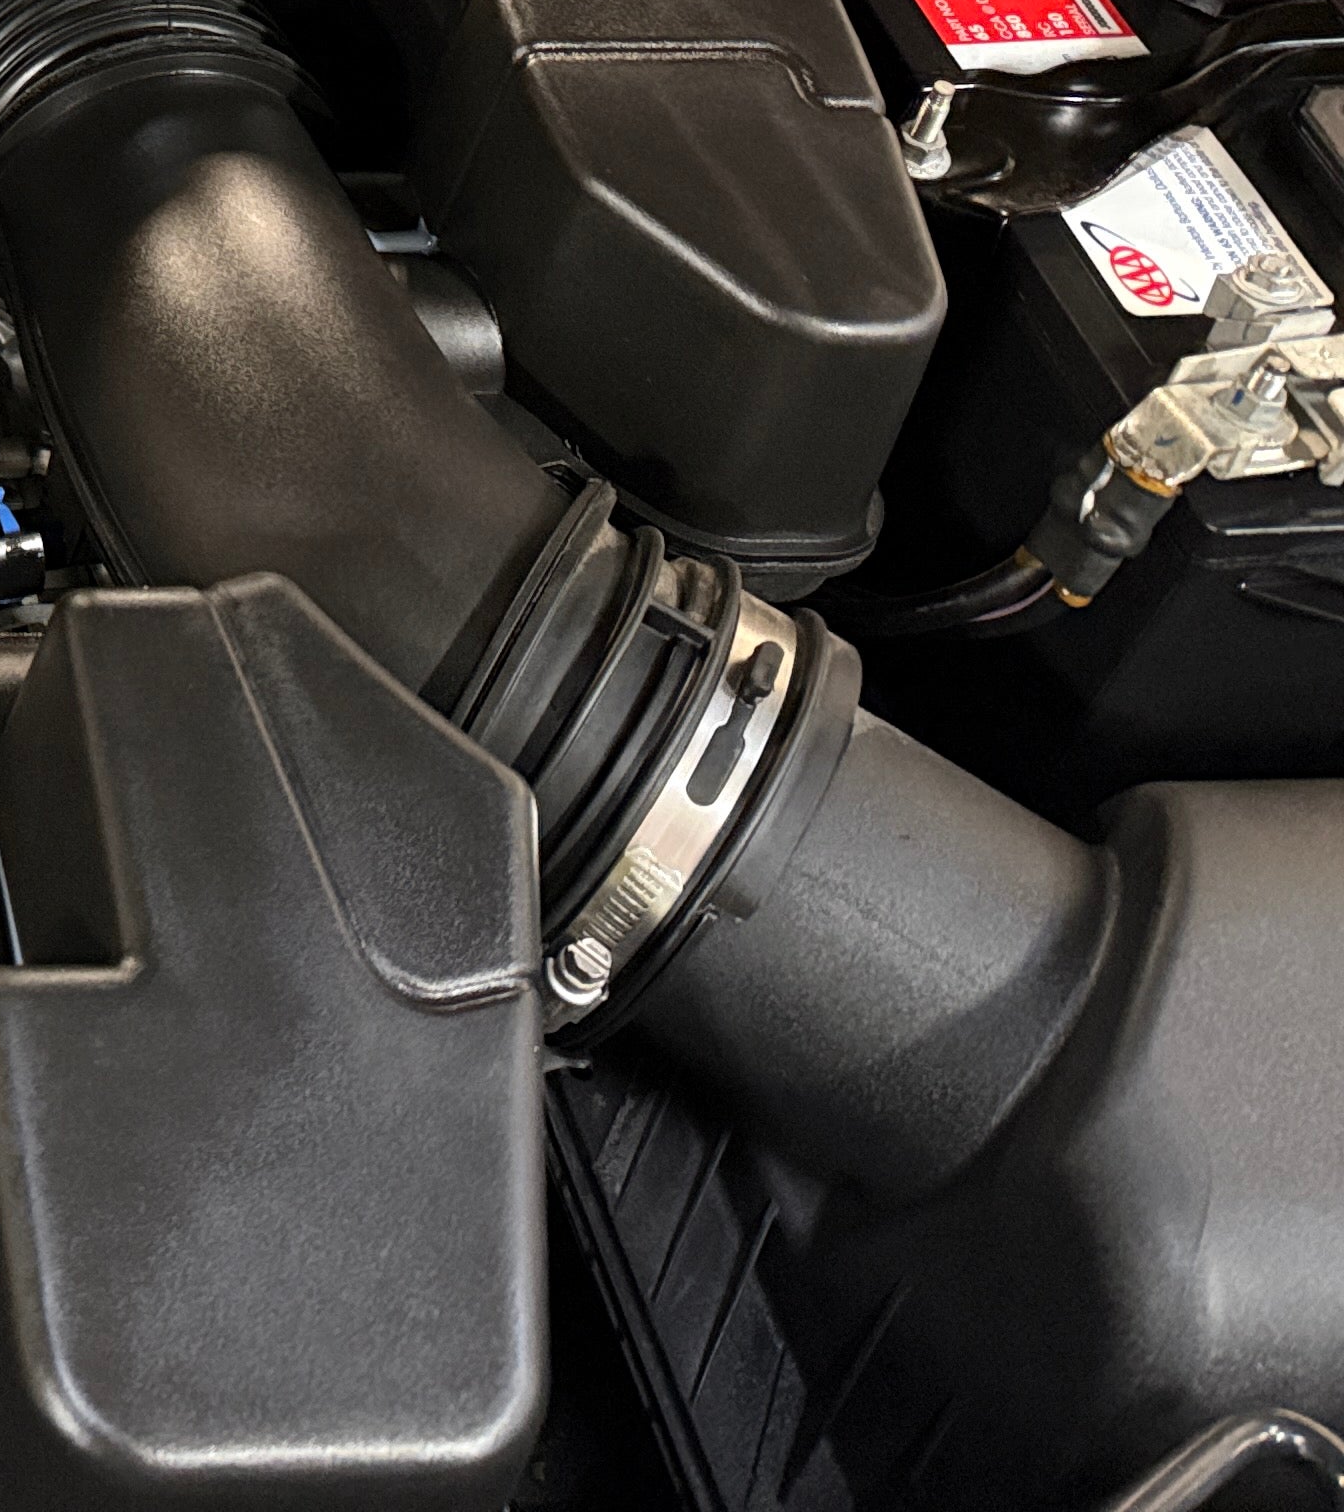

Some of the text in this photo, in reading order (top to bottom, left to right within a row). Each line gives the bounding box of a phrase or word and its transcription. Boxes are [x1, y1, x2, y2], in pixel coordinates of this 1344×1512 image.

[947, 18, 971, 41] PART
[990, 16, 1013, 39] CCA
[1006, 15, 1031, 38] 850
[1038, 23, 1056, 37] RC
[1048, 13, 1072, 35] 150
[1066, 5, 1094, 34] SERIAL
[969, 24, 989, 40] 65
